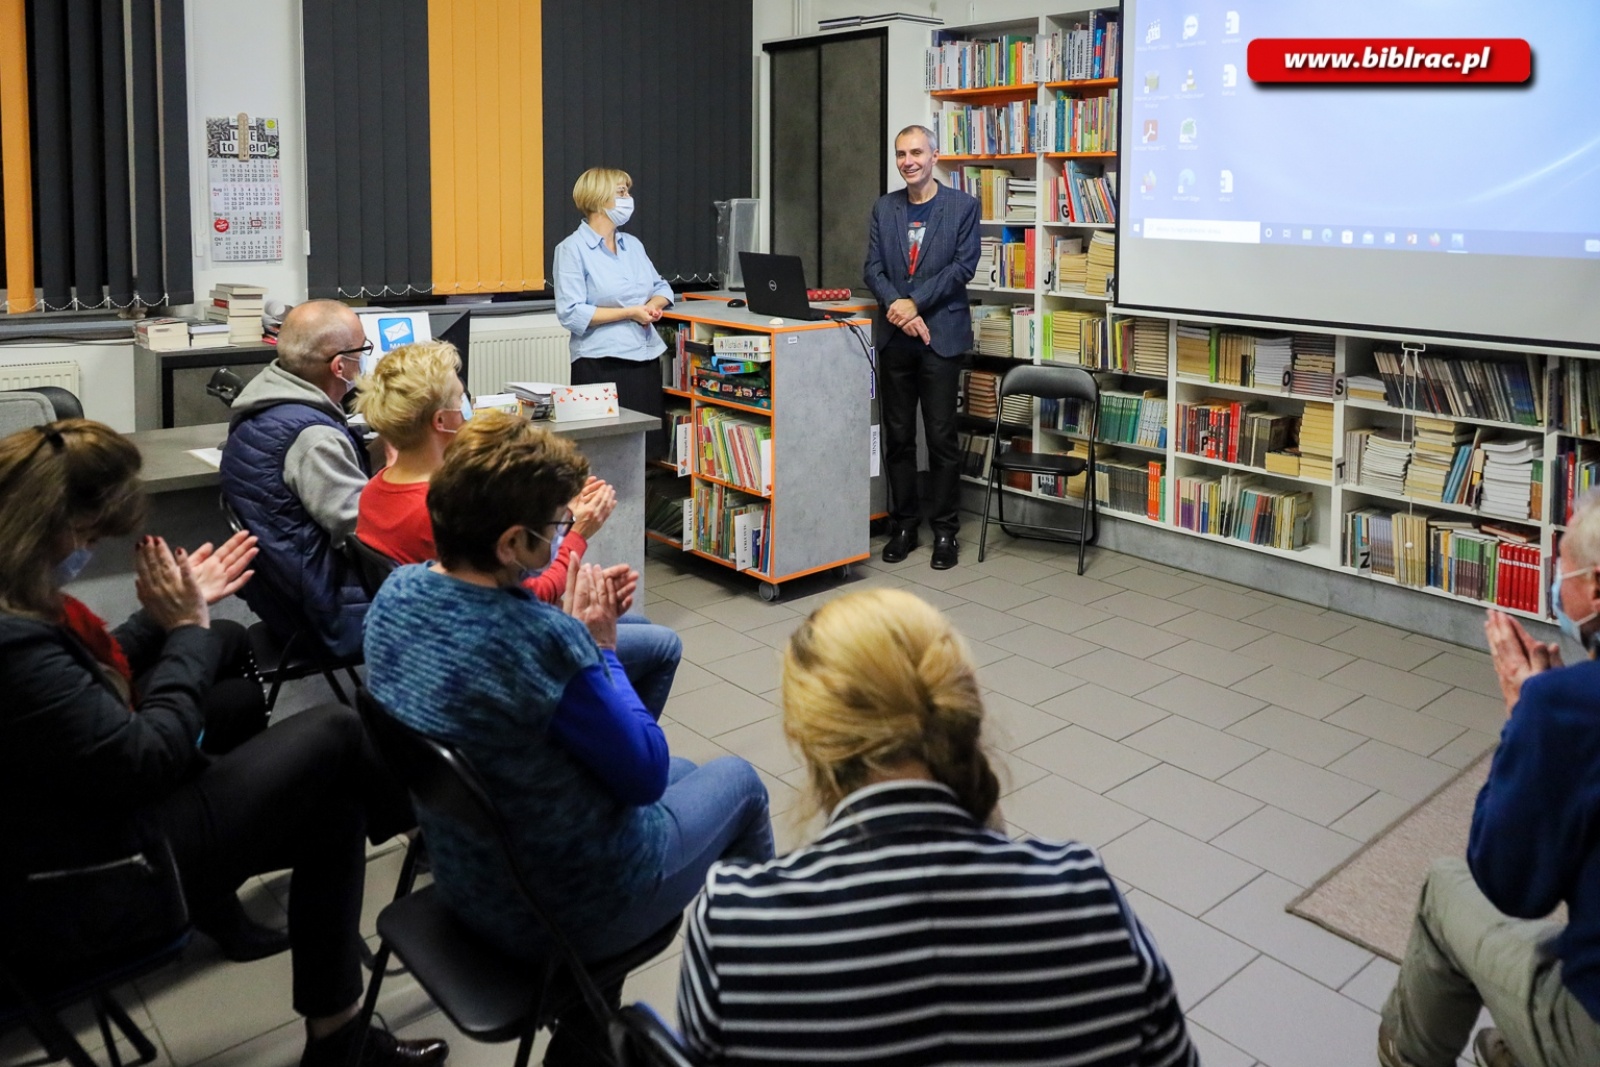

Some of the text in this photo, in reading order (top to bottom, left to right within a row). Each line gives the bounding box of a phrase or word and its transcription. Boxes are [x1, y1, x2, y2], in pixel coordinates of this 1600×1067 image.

[222, 142, 267, 152] to eld
[1061, 204, 1070, 218] G
[1044, 271, 1051, 285] J
[1282, 370, 1291, 387] O
[1335, 378, 1344, 396] S
[1201, 436, 1208, 451] P
[1336, 461, 1346, 479] T
[1360, 551, 1370, 569] Z
